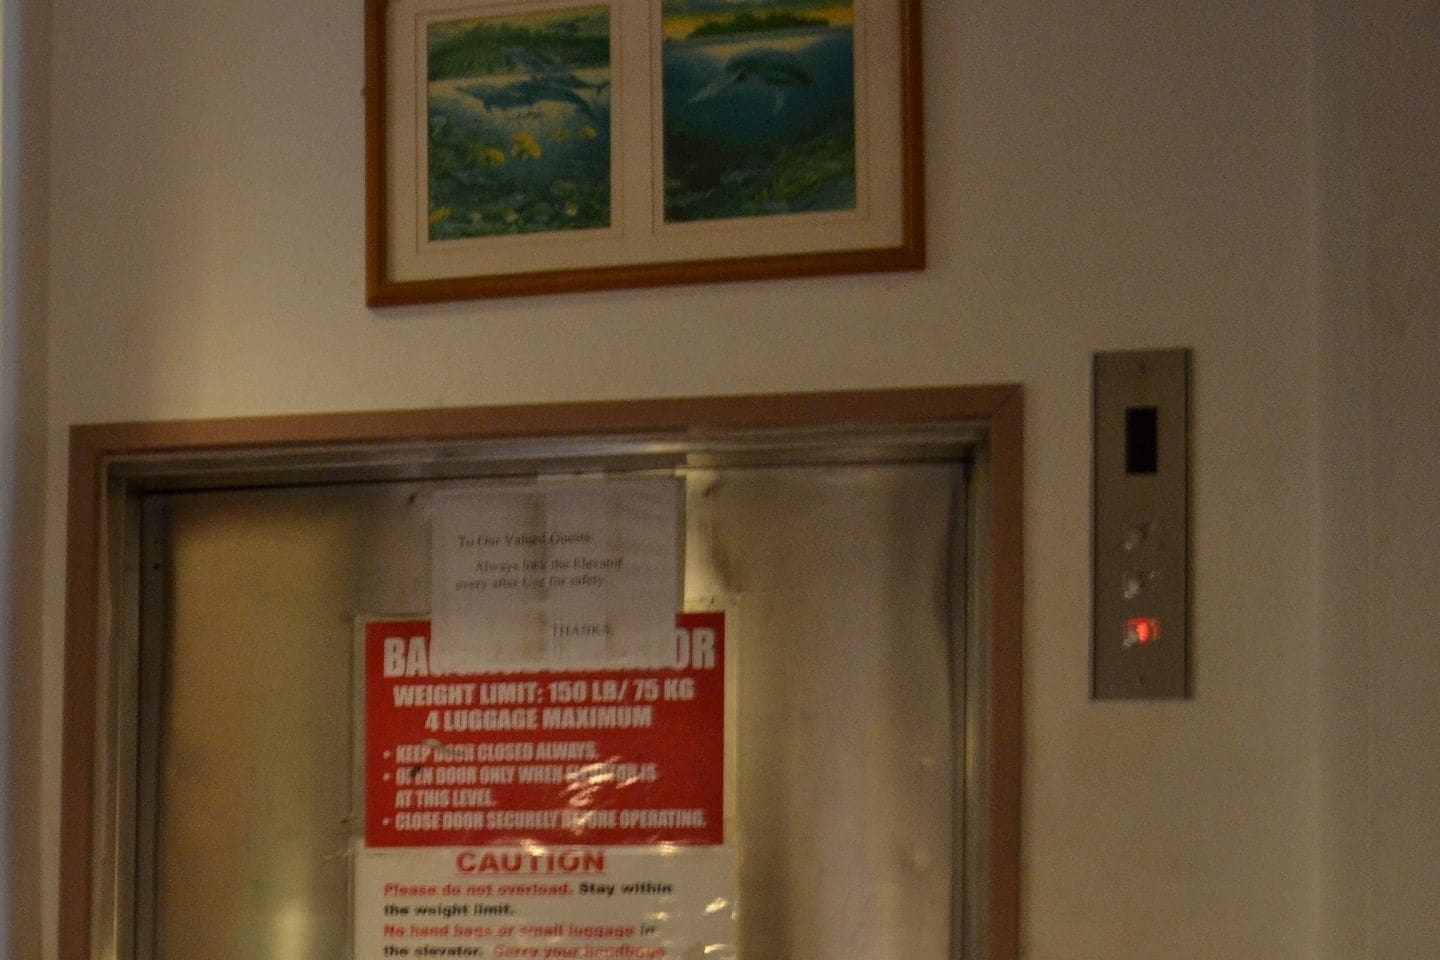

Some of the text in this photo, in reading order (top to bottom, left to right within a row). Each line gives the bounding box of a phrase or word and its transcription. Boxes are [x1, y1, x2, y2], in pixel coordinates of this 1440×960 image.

[393, 682, 476, 707] WEIGHT
[480, 680, 543, 706] LIMIT:
[547, 679, 587, 703] 150
[633, 677, 660, 701] 75
[664, 676, 695, 700] KG
[424, 704, 653, 732] 4 LUGGAGE MAXIMUM
[396, 743, 432, 764] KEEP
[433, 742, 475, 763] DOOR
[477, 741, 534, 762] CLOSED
[435, 765, 478, 785] DOOR
[479, 764, 516, 784] ONLY
[518, 763, 561, 784] WHEN
[395, 789, 413, 808] AT
[415, 788, 450, 808] THIS
[395, 811, 441, 831] CLOSE
[442, 810, 484, 831] DOOR
[486, 809, 559, 831] SECURELY
[456, 849, 605, 875] CAUTION
[384, 882, 437, 896] Please
[441, 883, 460, 896] do
[466, 883, 493, 896] not
[578, 881, 616, 897] Stay
[620, 881, 673, 896] within
[384, 903, 409, 916] the
[414, 903, 468, 919] weight
[384, 924, 405, 937] No
[409, 923, 448, 937] hand
[453, 924, 492, 938] bags
[497, 925, 514, 937] or
[519, 923, 564, 937] small
[569, 923, 636, 938] luggage
[384, 944, 409, 957] the
